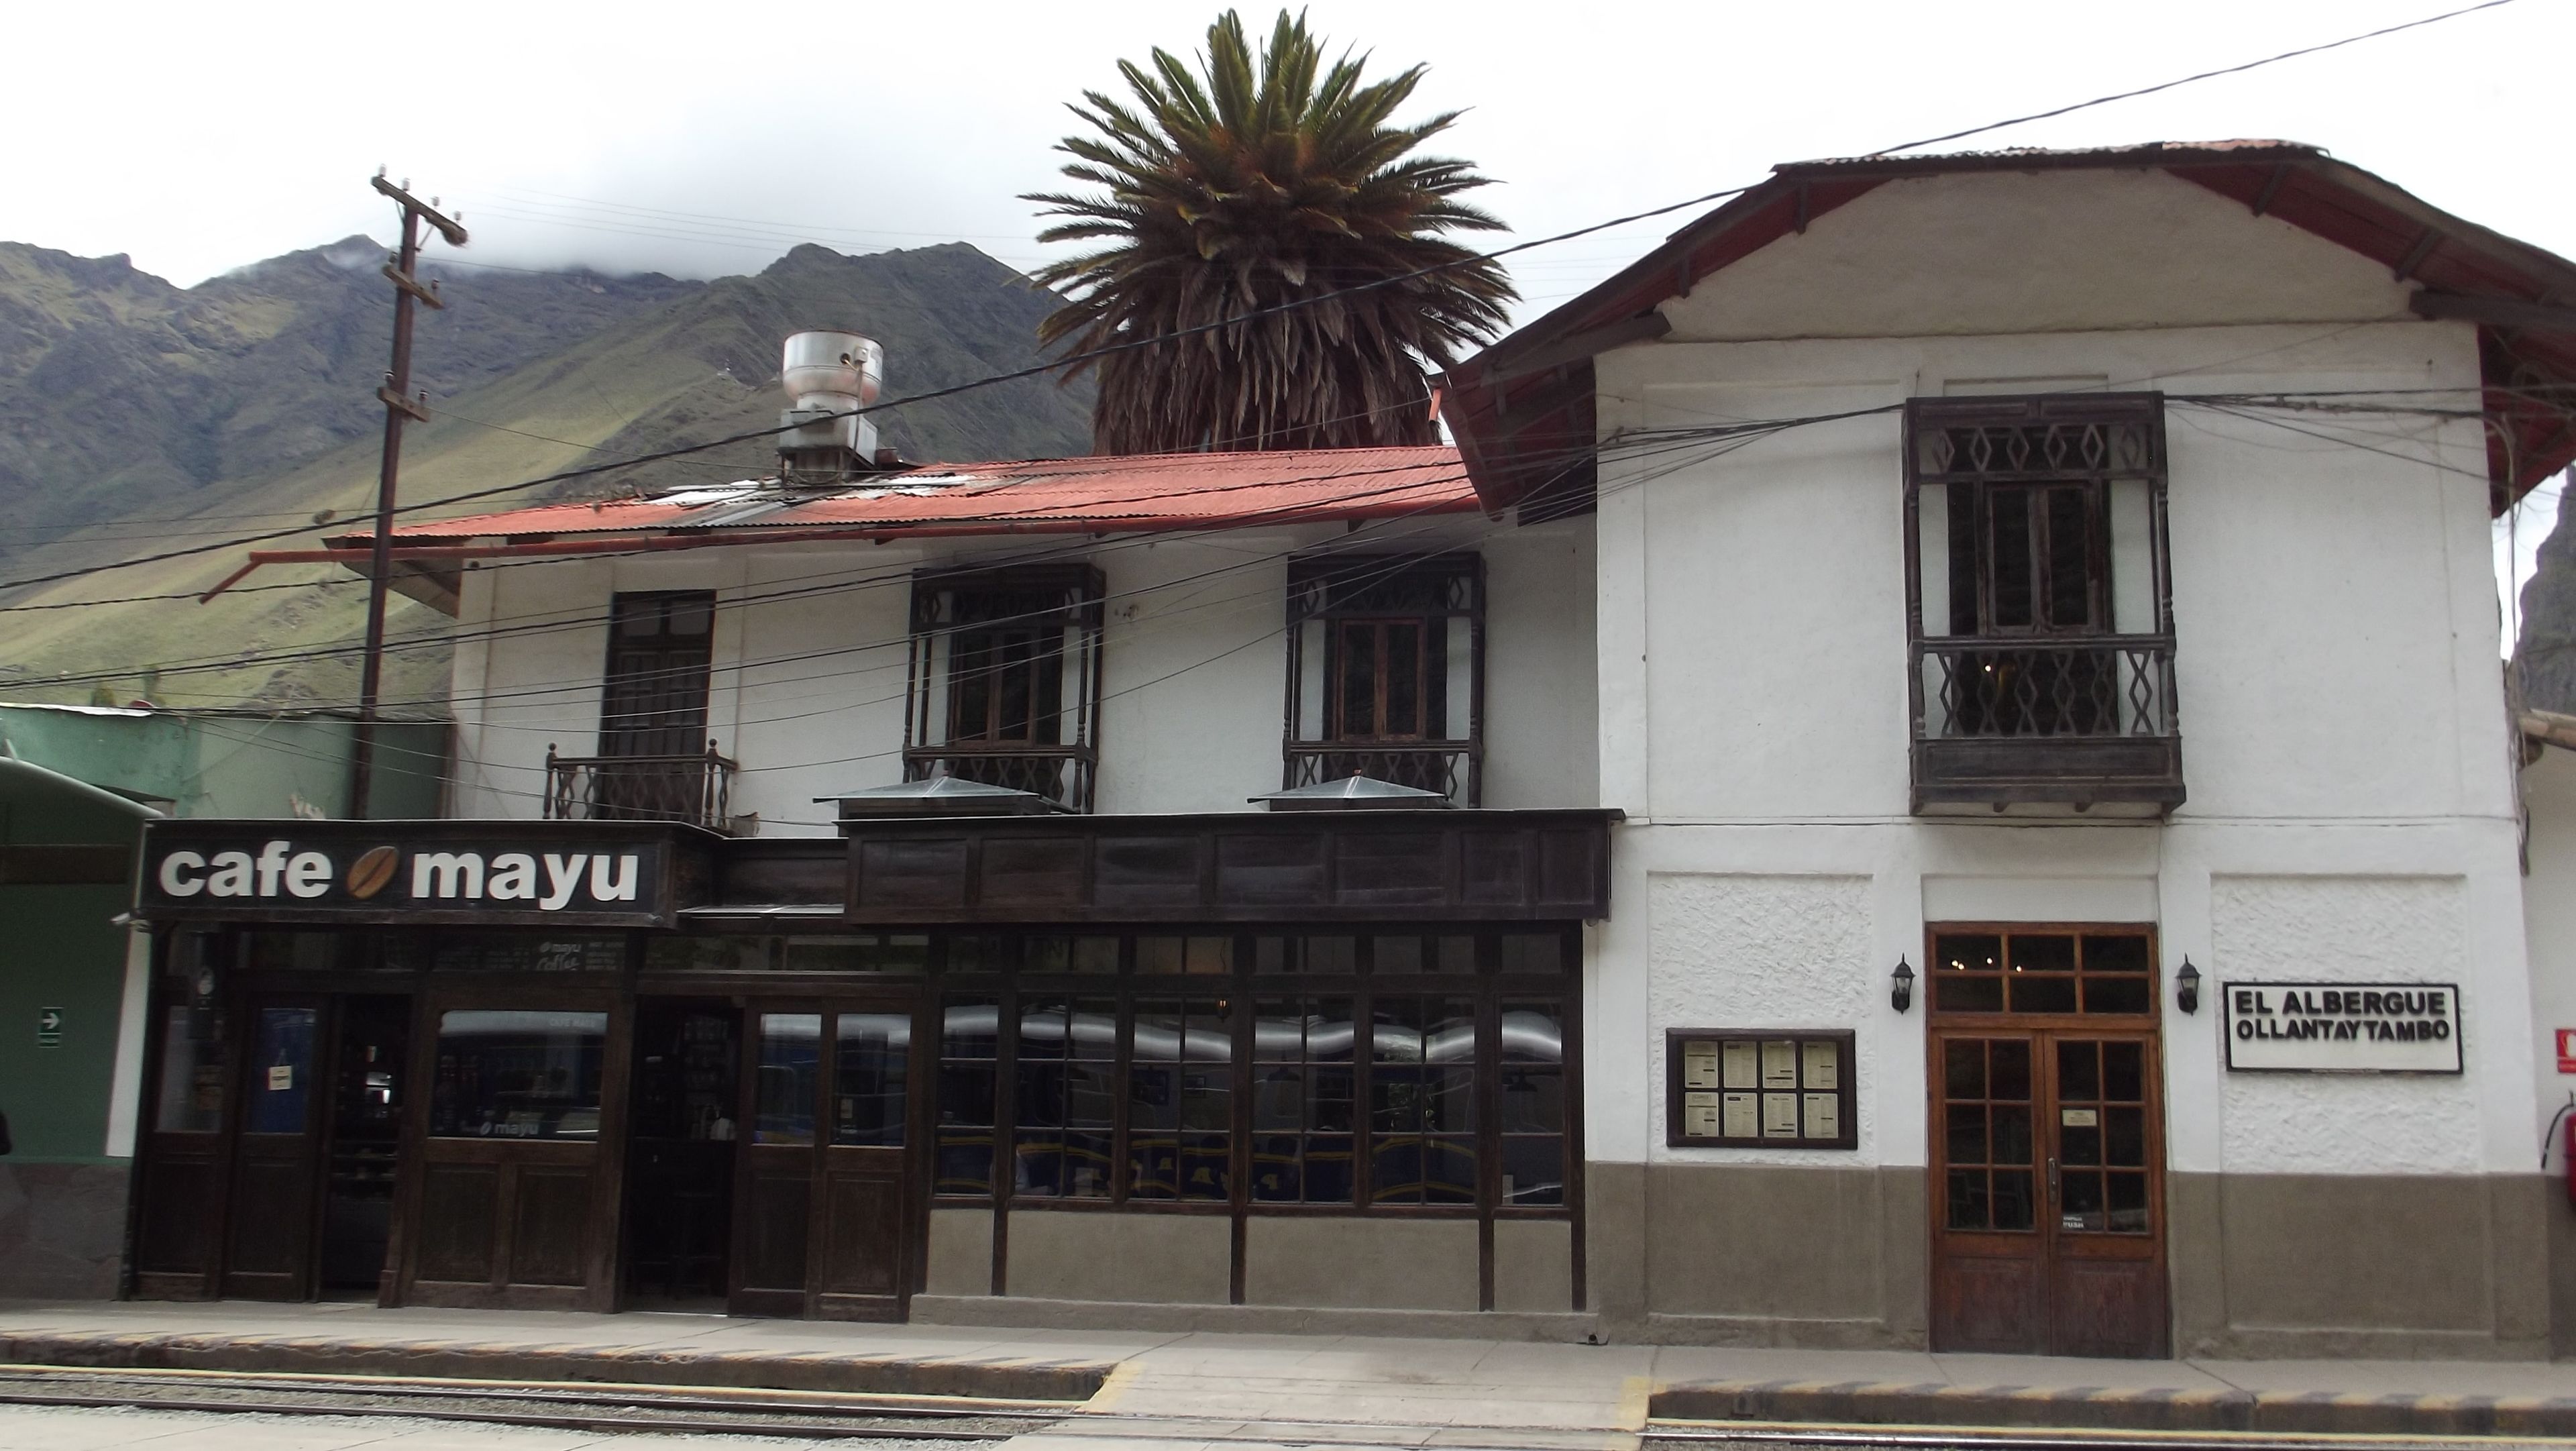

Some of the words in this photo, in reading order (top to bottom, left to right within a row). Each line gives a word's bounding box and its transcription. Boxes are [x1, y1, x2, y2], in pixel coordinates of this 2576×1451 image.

[160, 840, 333, 898] cafe
[412, 852, 639, 910] mayu
[551, 943, 581, 955] mayu
[2235, 990, 2273, 1016] EL
[2282, 991, 2446, 1017] ALBERGUE
[2237, 1018, 2450, 1042] OLLANTAYTAMBO
[494, 1123, 539, 1137] mayu
